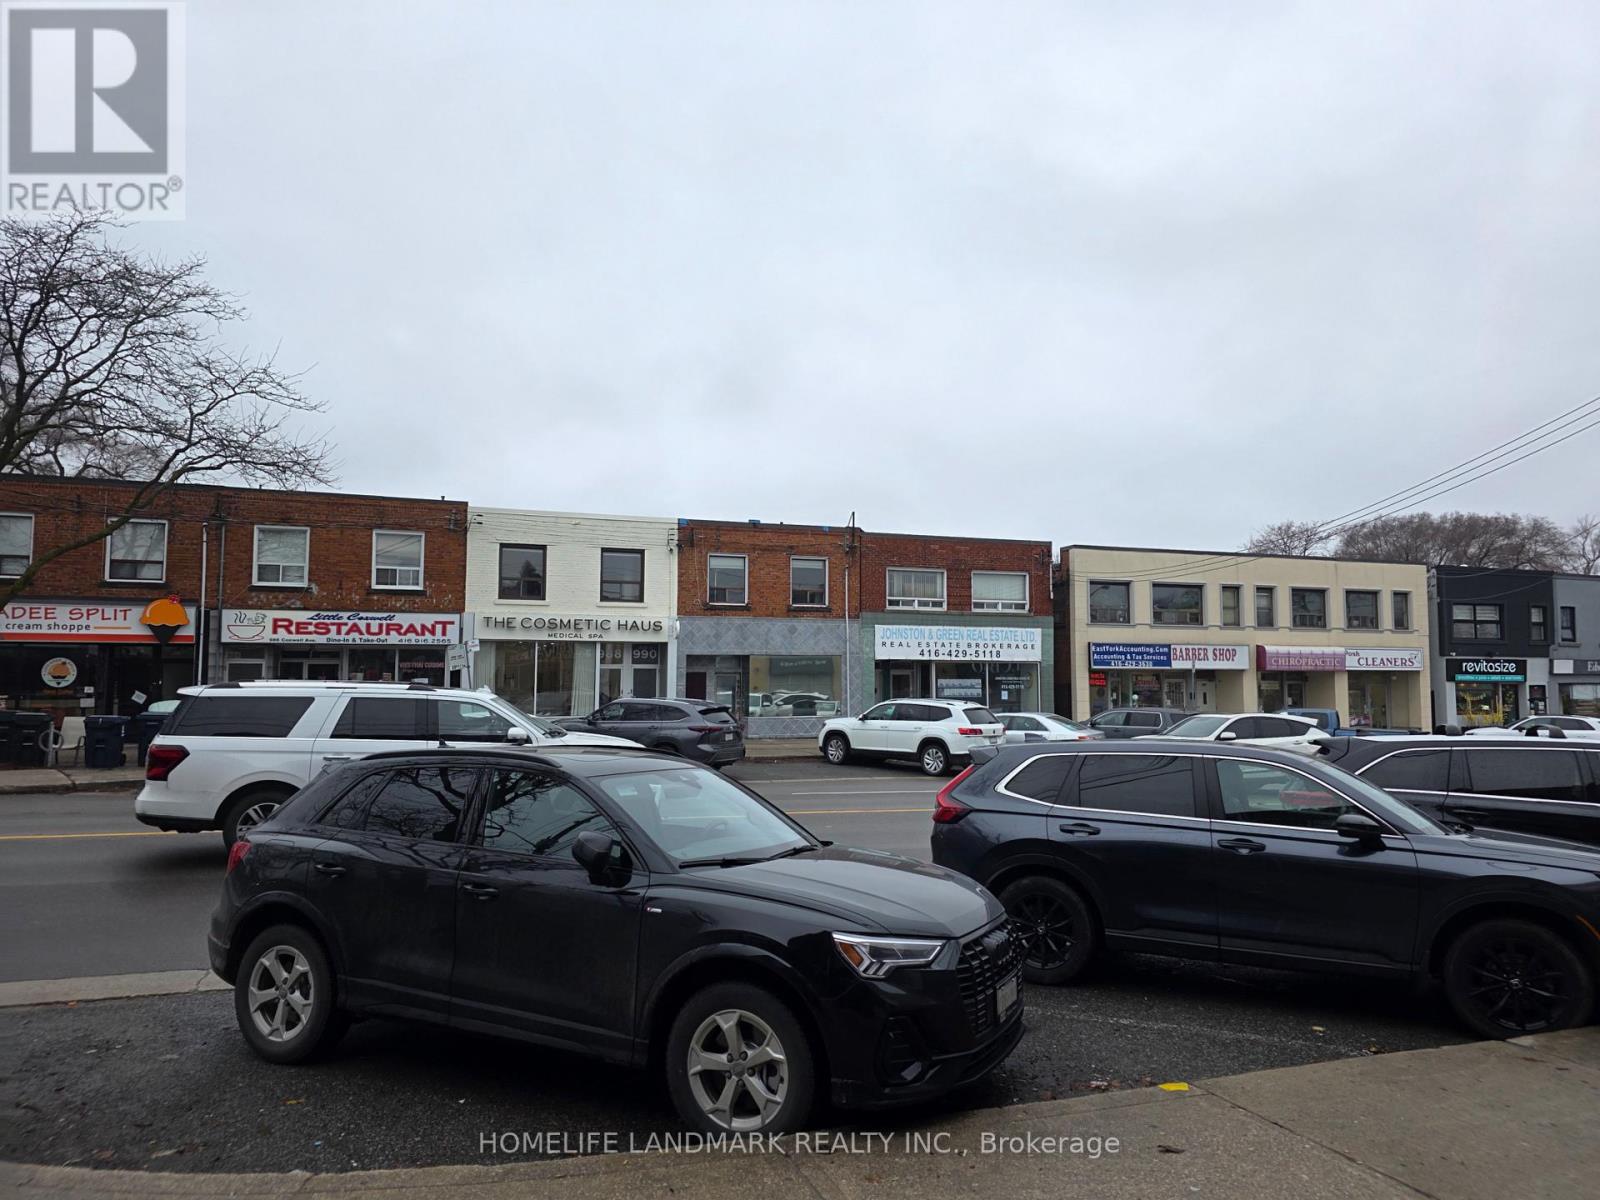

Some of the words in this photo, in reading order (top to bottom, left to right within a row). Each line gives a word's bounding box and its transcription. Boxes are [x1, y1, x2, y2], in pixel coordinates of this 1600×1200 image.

[68, 607, 132, 621] SPLIT
[307, 613, 344, 621] Little
[346, 613, 396, 621] Coxwell
[5, 622, 42, 630] cream
[47, 621, 91, 632] shoppe
[272, 617, 455, 637] RESTAURANT
[483, 616, 517, 629] THE
[520, 617, 612, 630] COSMETIC
[618, 619, 663, 632] HAUS
[880, 627, 925, 640] JOHNSTON
[928, 628, 934, 640] &
[935, 628, 964, 641] GREEN
[966, 629, 988, 641] REAL
[990, 629, 1019, 642] ESTATE
[633, 649, 657, 659] 990
[919, 649, 1001, 659] 416-429-5118
[1172, 647, 1209, 661] BARBER
[1213, 648, 1237, 662] SHOP
[1272, 657, 1341, 666] CHIROPRACTIC
[1462, 660, 1517, 673] revitasize
